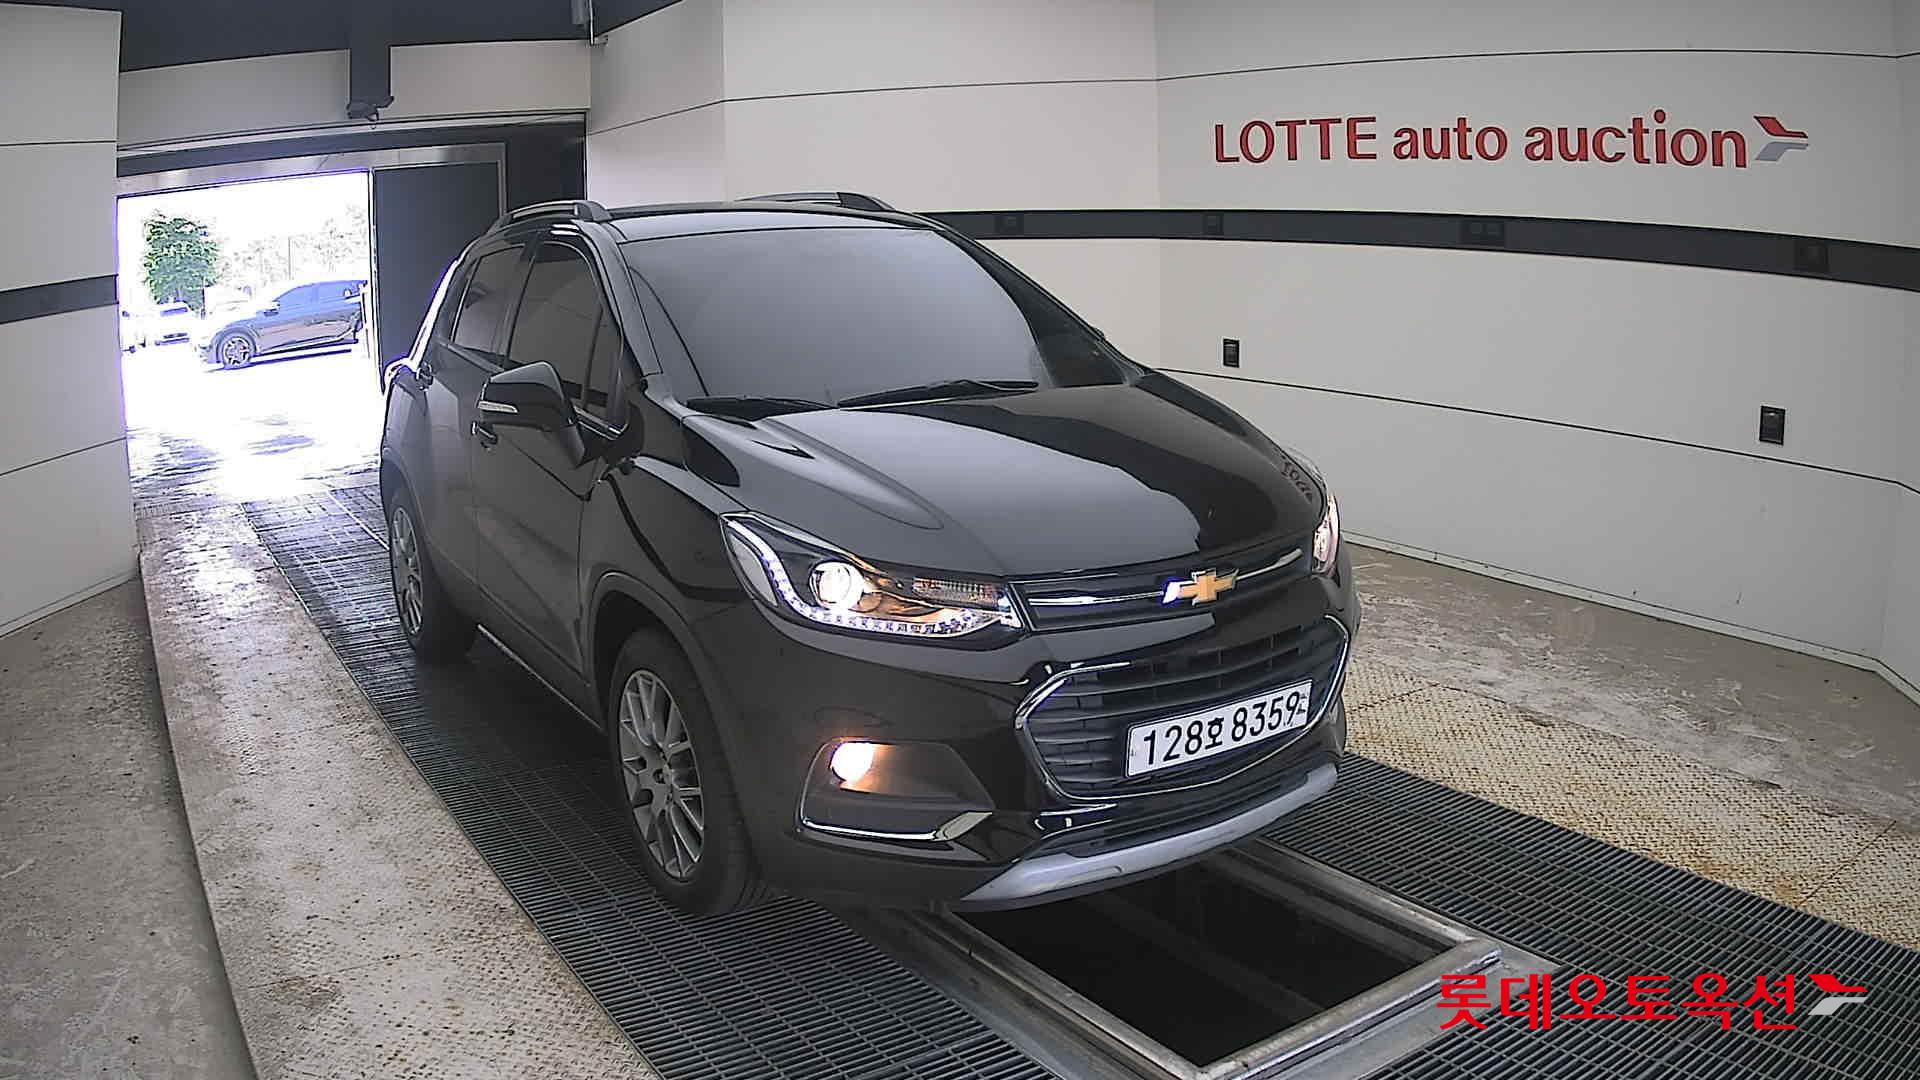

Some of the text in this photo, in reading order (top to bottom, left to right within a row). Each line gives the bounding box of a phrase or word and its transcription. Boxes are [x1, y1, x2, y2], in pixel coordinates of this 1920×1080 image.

[1214, 109, 1748, 169] LOTTE auto auction
[1143, 691, 1301, 766] 128호 8359
